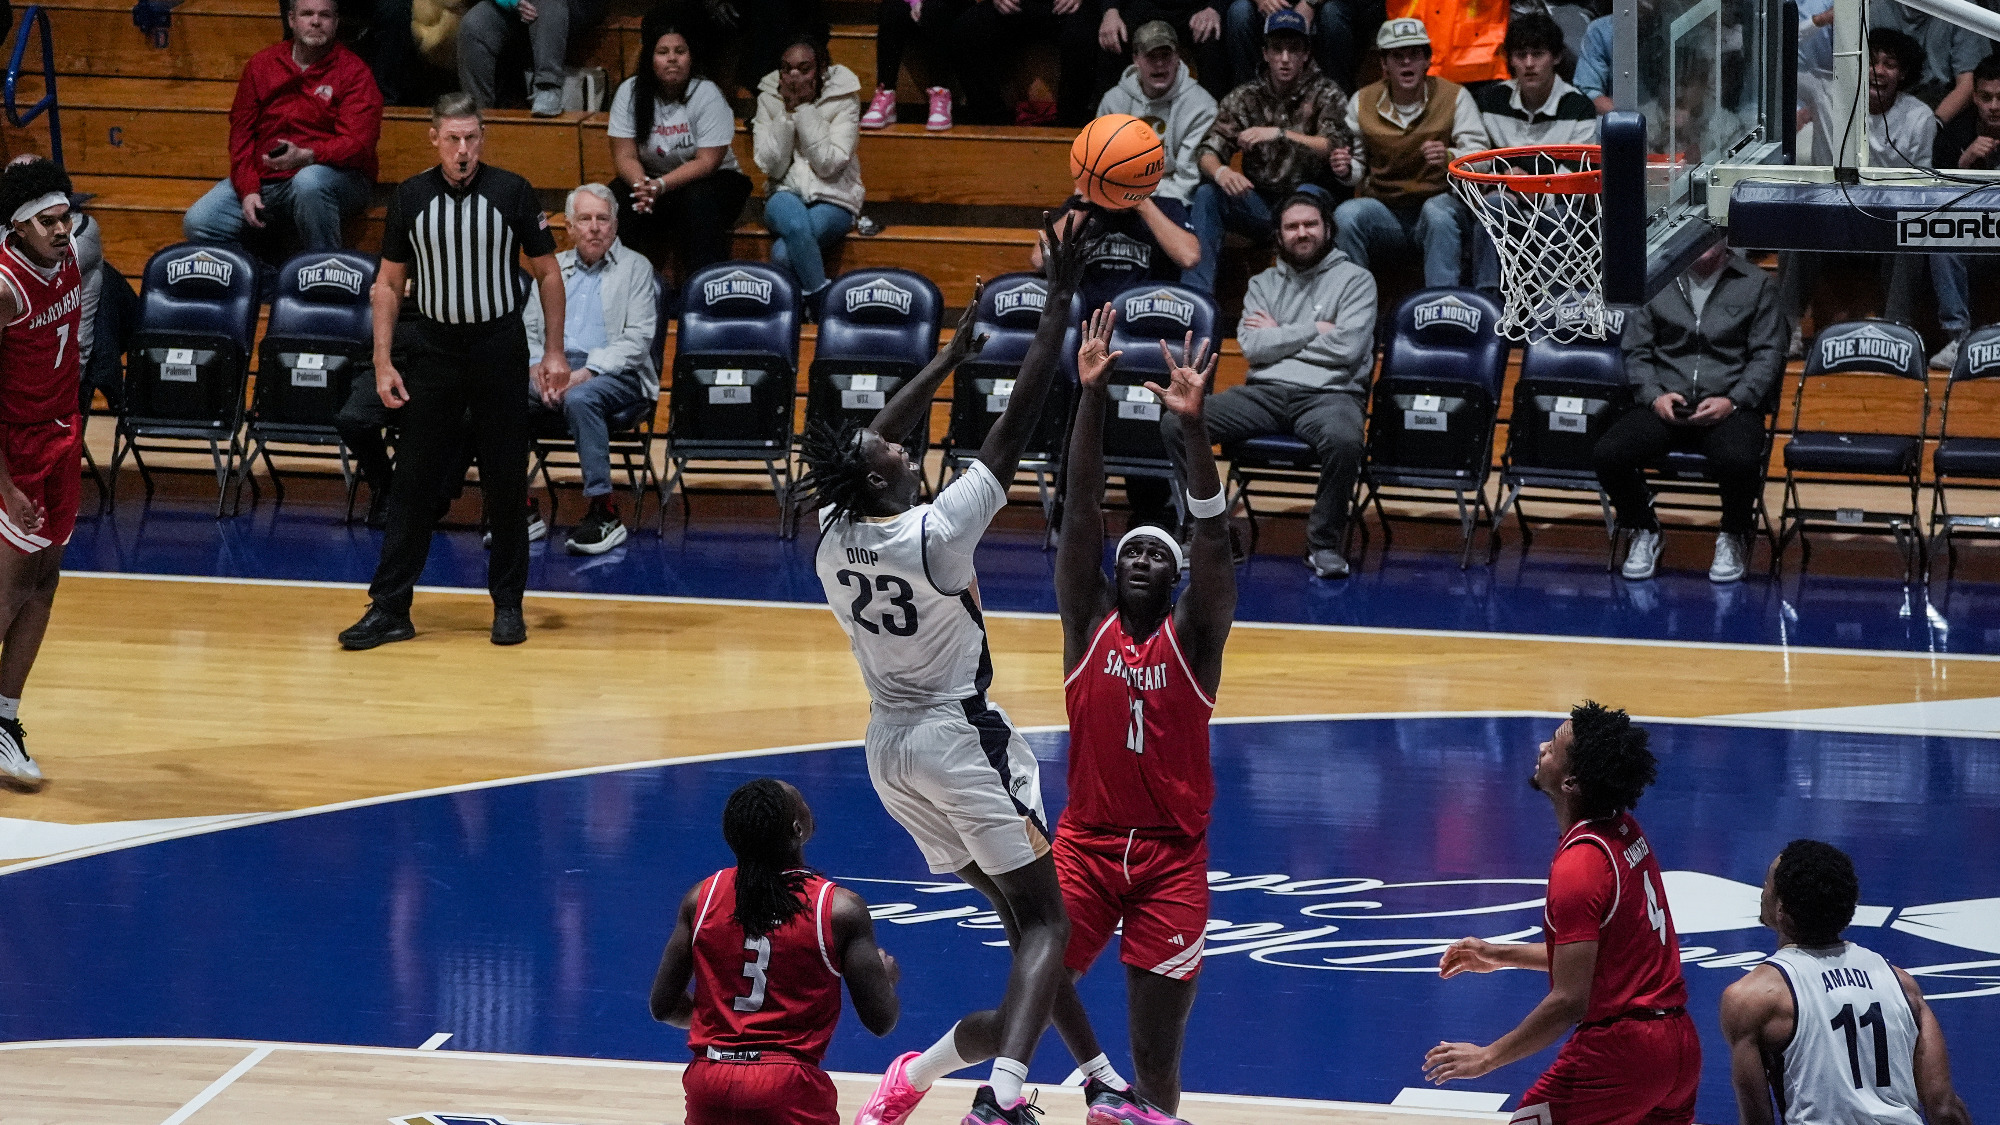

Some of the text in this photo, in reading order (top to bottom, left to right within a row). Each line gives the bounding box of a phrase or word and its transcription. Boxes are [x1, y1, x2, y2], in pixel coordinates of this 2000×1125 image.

[109, 126, 123, 147] C
[170, 260, 229, 283] THE MOUNT
[301, 268, 360, 290] THE MOUNT
[708, 280, 769, 301] THE MOUNT
[849, 288, 910, 310] THE MOUNT
[998, 292, 1046, 311] THE MOU
[1129, 299, 1191, 322] THE MOUNT
[1417, 306, 1479, 327] THE MOUNT
[54, 323, 70, 369] 7
[1825, 338, 1909, 367] THE MOUNT
[846, 547, 879, 566] DIOP
[836, 569, 919, 637] 23
[1643, 869, 1667, 946] 4
[733, 934, 771, 1012] 3
[1821, 967, 1873, 993] AMADI
[1830, 1002, 1891, 1090] 11
